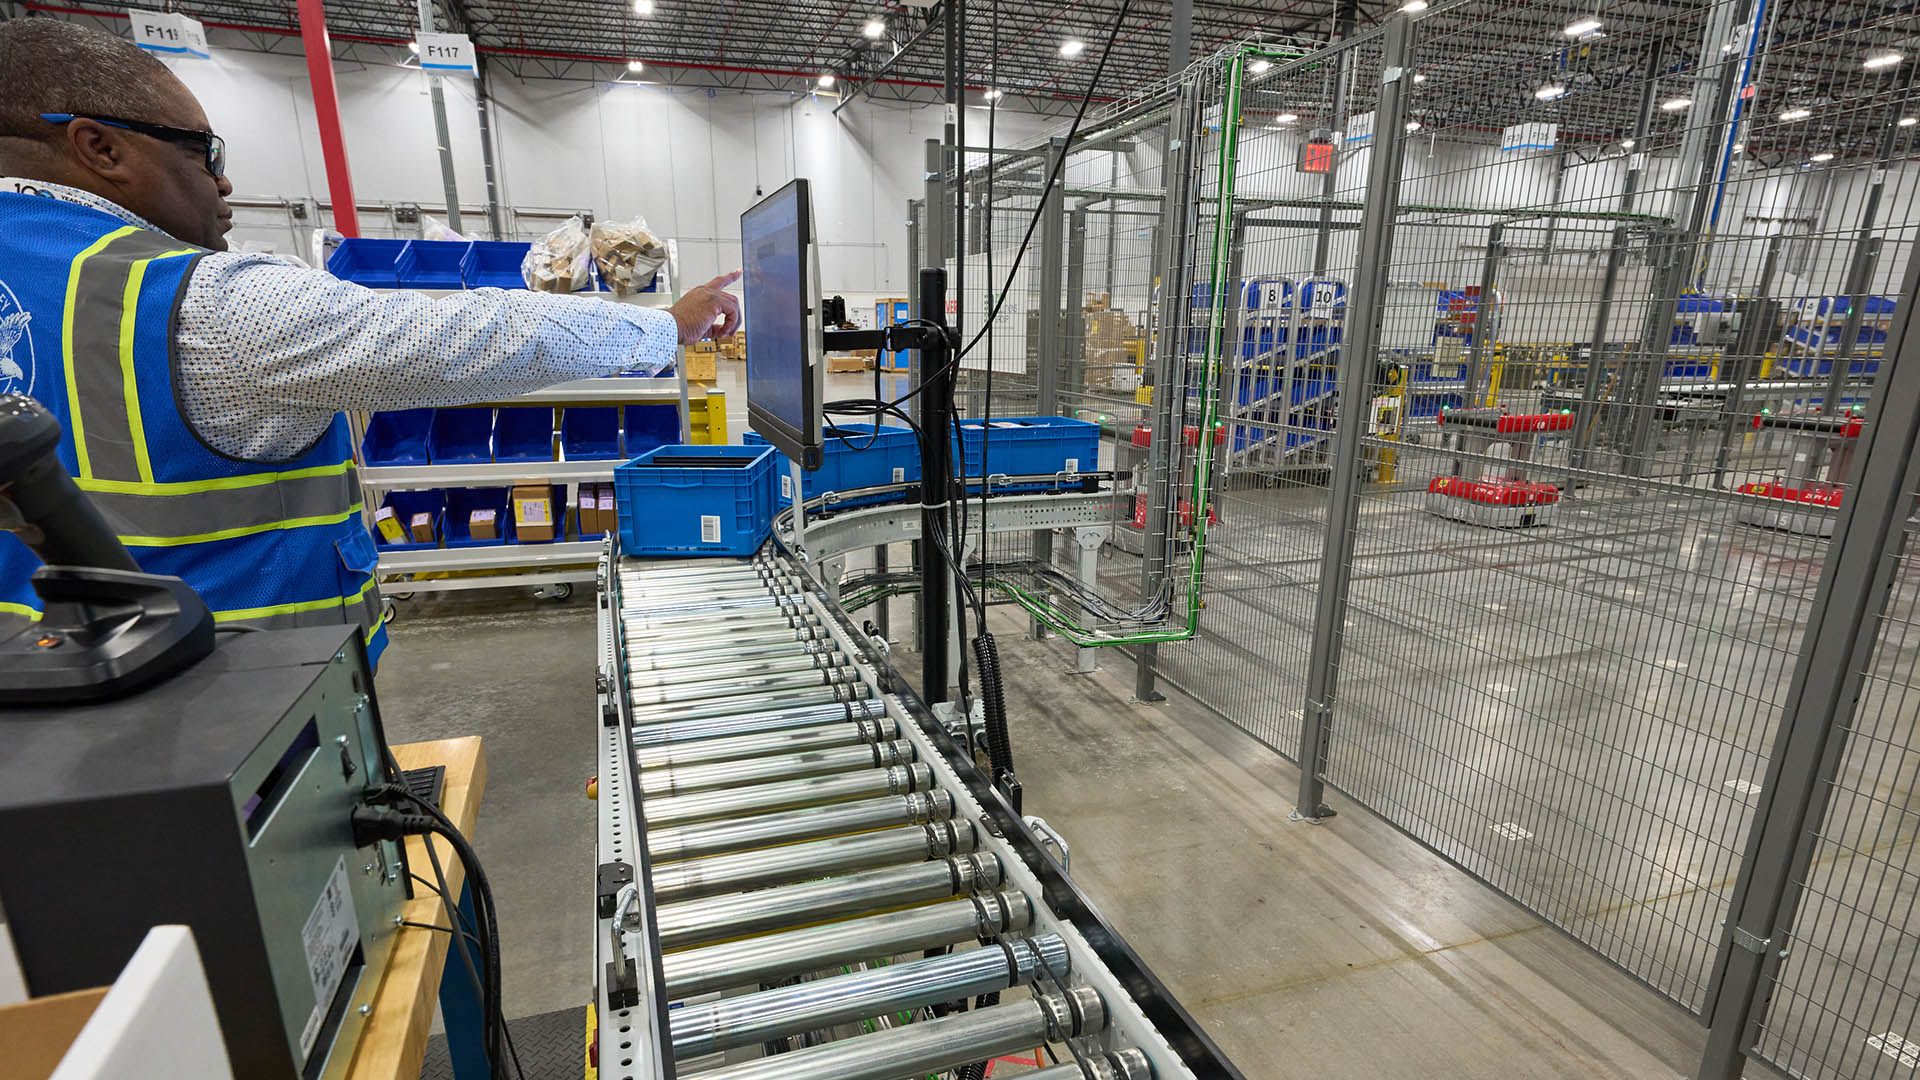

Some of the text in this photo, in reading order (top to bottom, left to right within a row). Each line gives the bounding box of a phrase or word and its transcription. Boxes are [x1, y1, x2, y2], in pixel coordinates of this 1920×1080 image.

[428, 45, 458, 58] F117
[1304, 144, 1333, 171] EXIT
[1268, 289, 1276, 302] 8
[1316, 290, 1332, 304] 10
